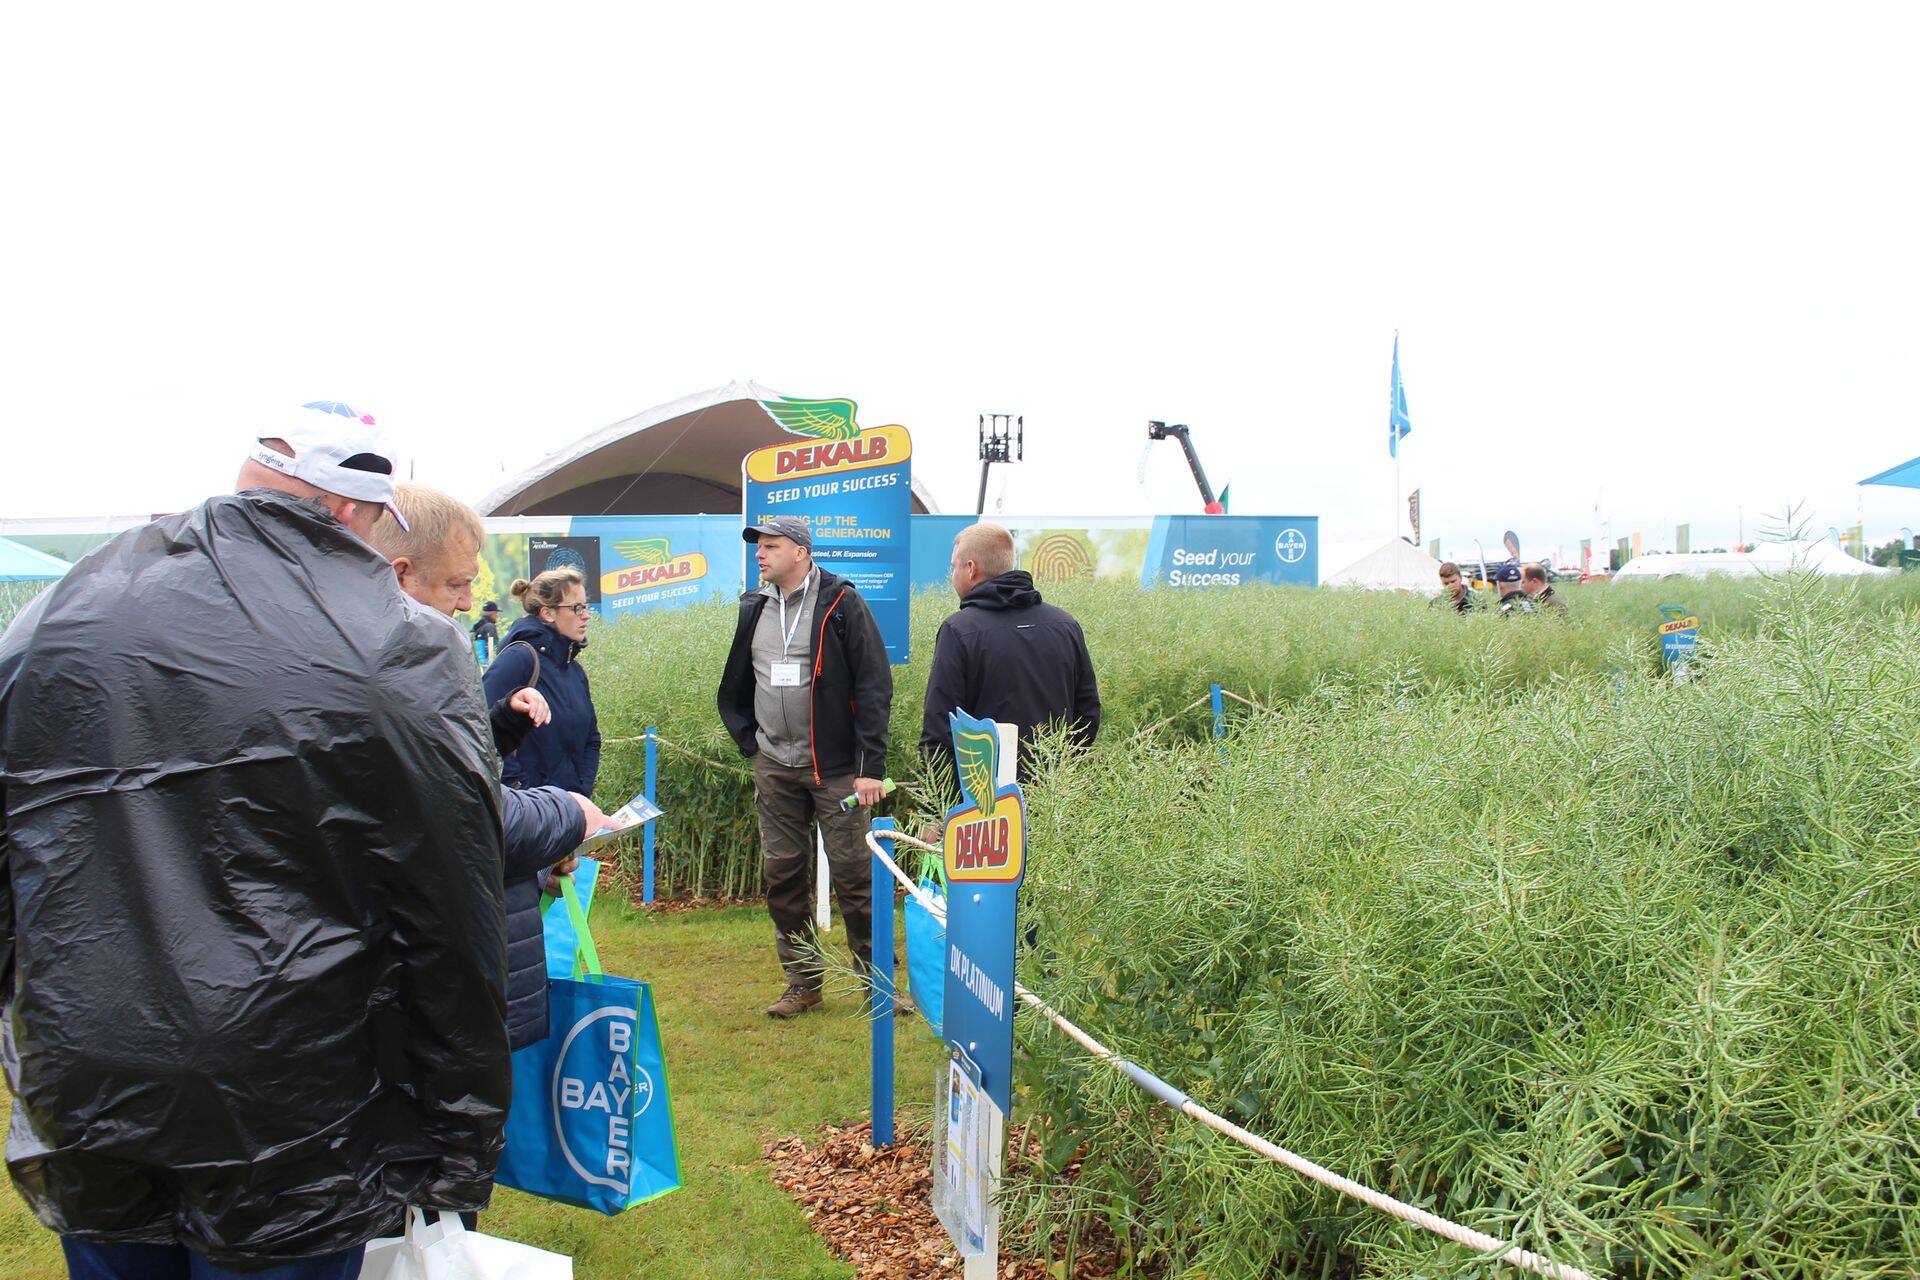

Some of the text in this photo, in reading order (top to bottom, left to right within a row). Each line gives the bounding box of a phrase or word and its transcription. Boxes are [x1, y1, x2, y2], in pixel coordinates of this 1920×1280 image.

[776, 437, 887, 475] DEKALB
[767, 473, 897, 504] SEED YOUR SUCCESS
[816, 528, 891, 539] GENERATION
[834, 515, 857, 526] THE
[832, 550, 842, 558] DK
[843, 550, 877, 559] Expansion
[1172, 549, 1256, 569] Seed your
[1278, 542, 1304, 550] BAYER
[617, 561, 691, 590] DEKALB
[1168, 570, 1240, 587] Success
[612, 584, 699, 609] SEED YOUR SUCCESS
[955, 817, 1009, 870] DEKALB
[950, 943, 1004, 1022] DK PLATINIUM
[561, 1076, 632, 1115] BAY
[606, 1021, 632, 1181] BAYER
